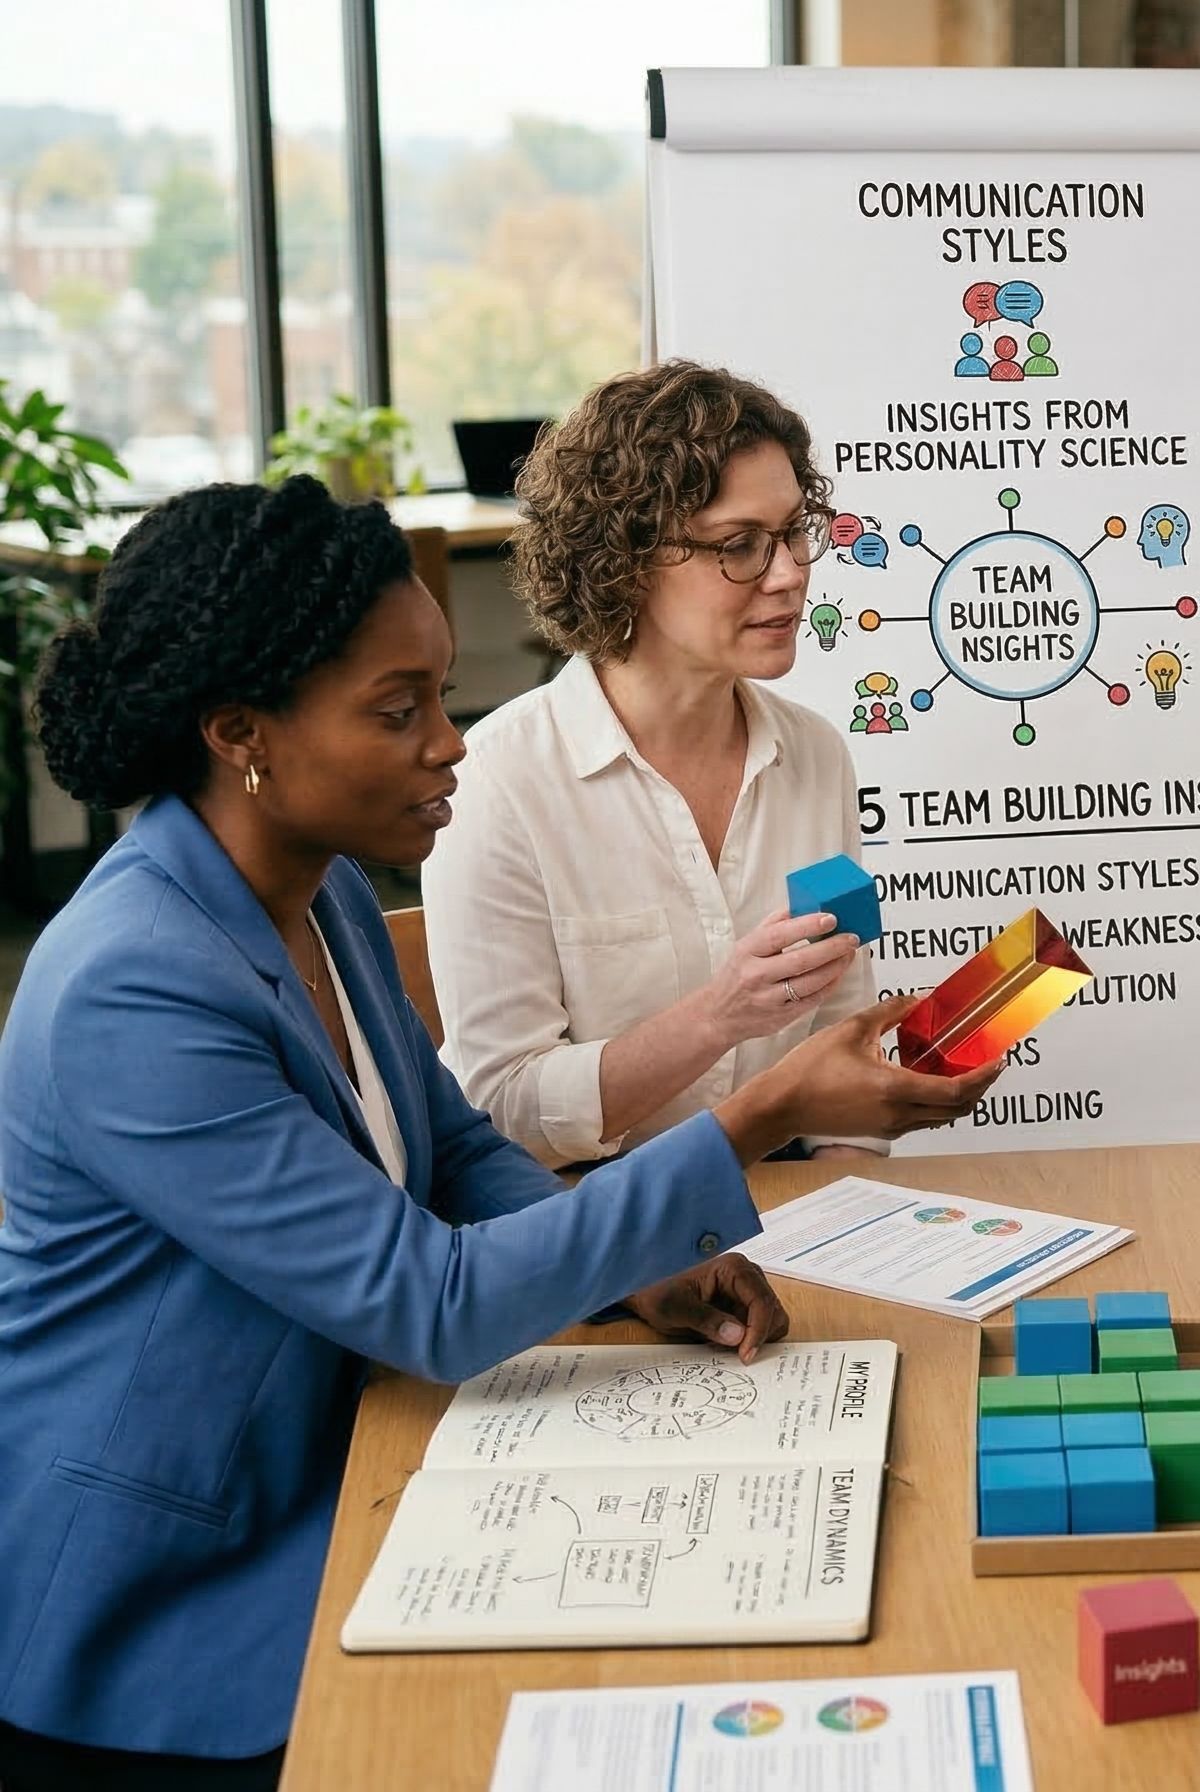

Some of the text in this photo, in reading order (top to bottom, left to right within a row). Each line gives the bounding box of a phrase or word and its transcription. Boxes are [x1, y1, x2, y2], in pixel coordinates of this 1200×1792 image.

[858, 182, 1145, 218] COMMUNICATION
[942, 227, 1068, 263] STYLES
[886, 399, 1130, 433] INSIGHTS FROM
[835, 436, 1189, 473] PERSONALITY SCIENCE
[972, 565, 1053, 594] TEAM
[950, 599, 1081, 631] BUILDING
[961, 634, 1076, 664] NSIGHTS
[860, 786, 887, 835] 5
[899, 789, 992, 827] TEAM
[1003, 781, 1153, 822] BUILDING
[875, 857, 1200, 903] OMMUNICATION STYLES
[869, 925, 1005, 960] TRENGT
[1062, 971, 1177, 1007] LUTION
[972, 1089, 1104, 1127] BUILDING
[841, 1360, 871, 1419] MY PROFILE
[821, 1467, 855, 1586] TEAM DYNAMICS
[1113, 1657, 1188, 1683] Insights
